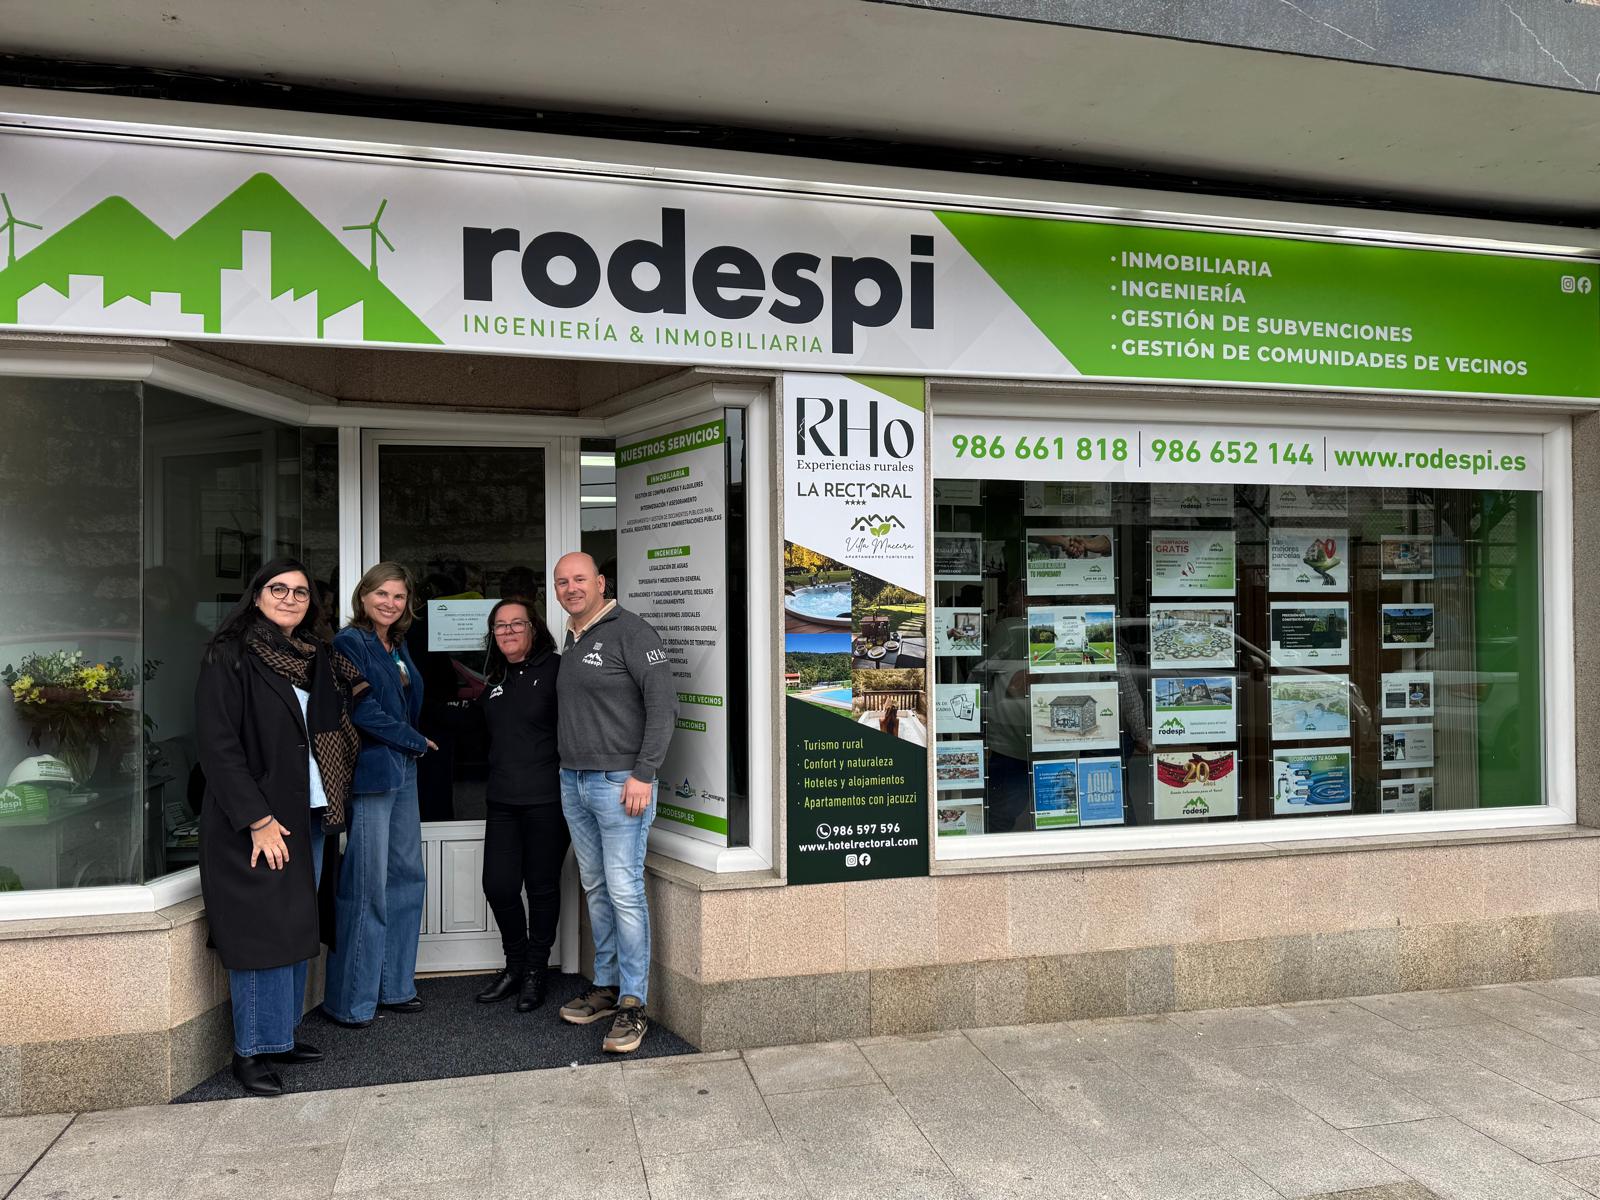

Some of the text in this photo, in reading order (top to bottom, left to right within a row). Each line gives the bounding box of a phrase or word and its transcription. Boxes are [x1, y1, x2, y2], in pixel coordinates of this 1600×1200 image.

[1121, 250, 1272, 278] INMOBILIARIA
[463, 207, 934, 355] rodespi
[1121, 280, 1246, 304] INGENIERÍA
[1121, 308, 1413, 343] GESTIÓN DE SUBVENCIONES
[463, 314, 823, 354] INGENIERÍA & INMOBILIARIA
[1121, 338, 1528, 376] GESTIÓN DE COMUNIDADES DE VECINOS
[796, 397, 914, 458] RHo
[621, 426, 720, 463] NUESTROS SERVICIOS
[952, 434, 1527, 474] 986 661 818 986 652 144 www.rodespi.es
[797, 460, 914, 472] Experiencias rurales
[650, 470, 685, 483] INMOBILIARIA
[797, 482, 819, 497] LA
[654, 547, 682, 558] INGENIERÍA
[1155, 545, 1189, 553] GRATIS
[698, 696, 721, 705] VECINOS
[1158, 728, 1185, 736] rodespi
[804, 738, 864, 751] Turismo rural
[804, 756, 894, 770] Confort y naturaleza
[1182, 761, 1210, 784] 20
[804, 774, 905, 789] Hoteles y alojamientos
[804, 792, 917, 810] Apartamentos con jacuzzi
[1182, 806, 1209, 815] rodespi
[832, 823, 900, 836] 986 597 596
[799, 838, 918, 852] www.hotelrectoral.com
